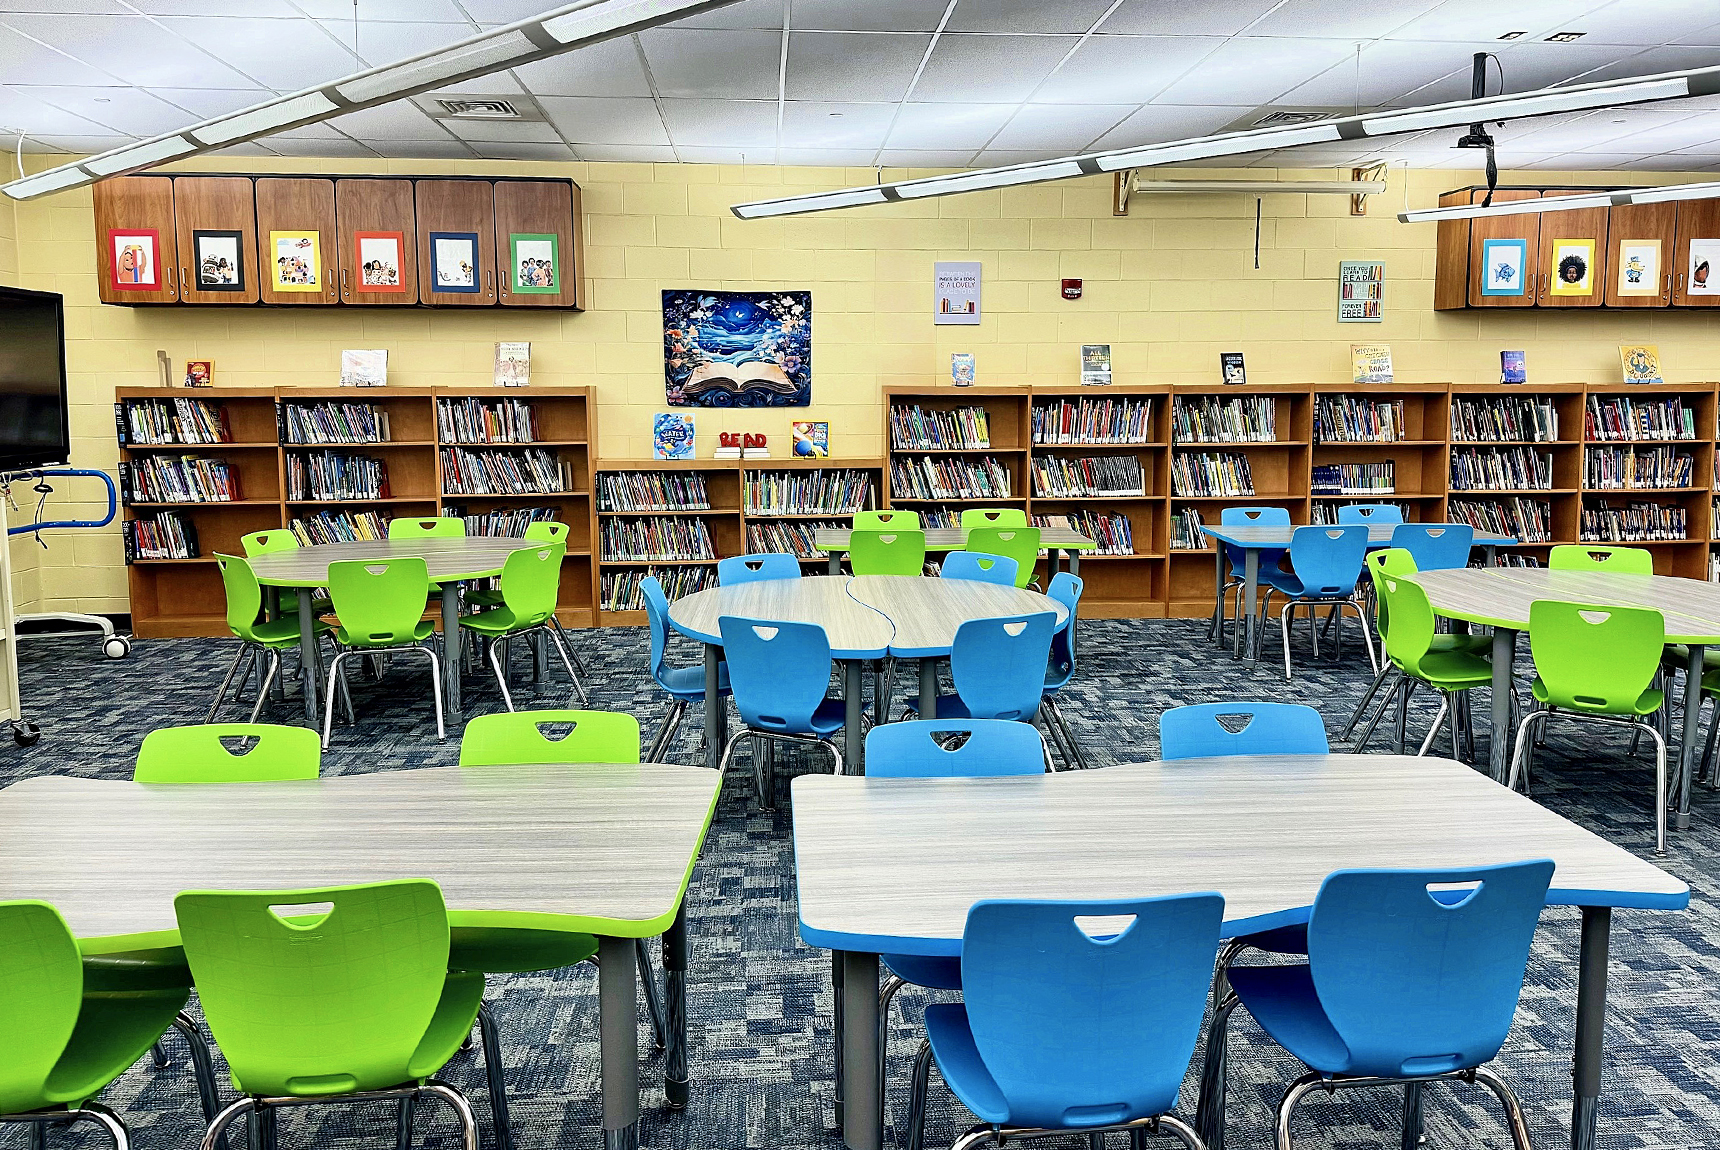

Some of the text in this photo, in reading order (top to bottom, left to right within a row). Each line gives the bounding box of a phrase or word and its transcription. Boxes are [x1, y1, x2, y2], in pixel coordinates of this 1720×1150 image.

[1342, 309, 1362, 317] FREE
[1368, 364, 1390, 373] ROAD?
[661, 430, 685, 438] WATER
[719, 432, 767, 448] READ
